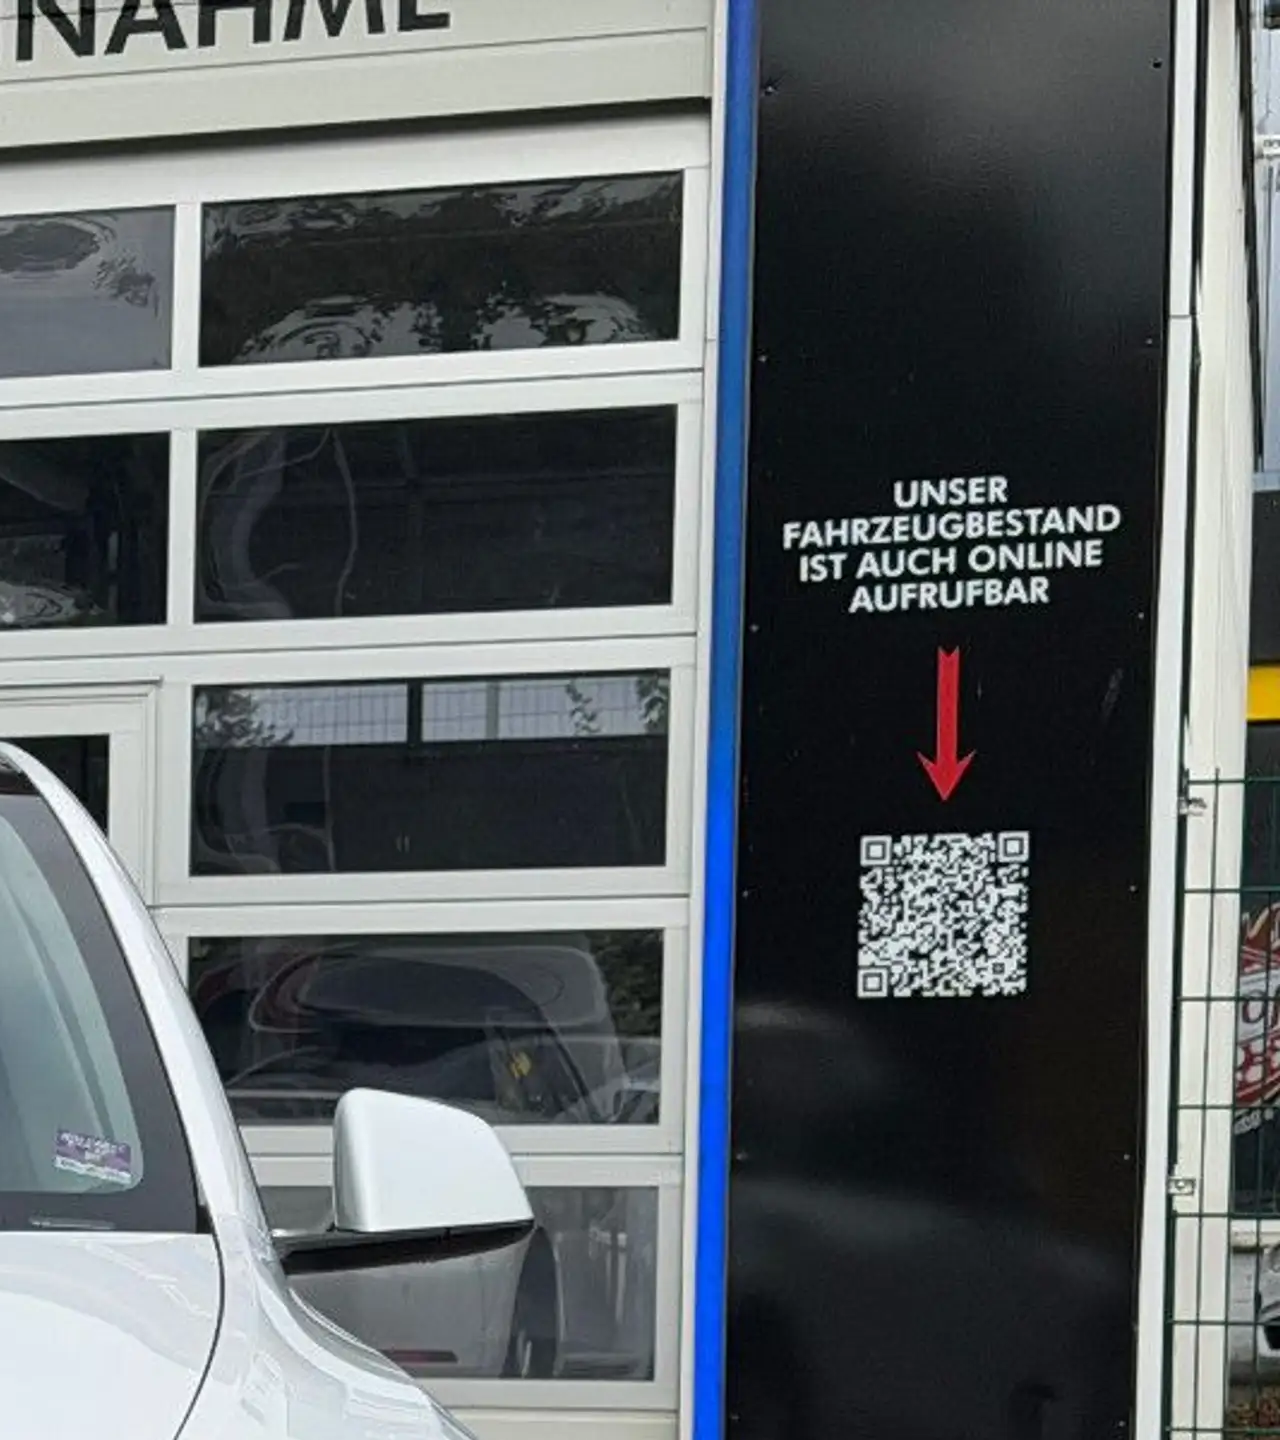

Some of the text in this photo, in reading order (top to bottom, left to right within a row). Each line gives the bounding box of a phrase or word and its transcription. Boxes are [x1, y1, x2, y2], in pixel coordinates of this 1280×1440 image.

[893, 475, 1008, 508] UNSER
[783, 504, 1121, 550] FAHRZEUGBESTAND
[799, 539, 1103, 582] IST AUCH ONLINE
[848, 576, 1050, 613] AUFRUFBAR
